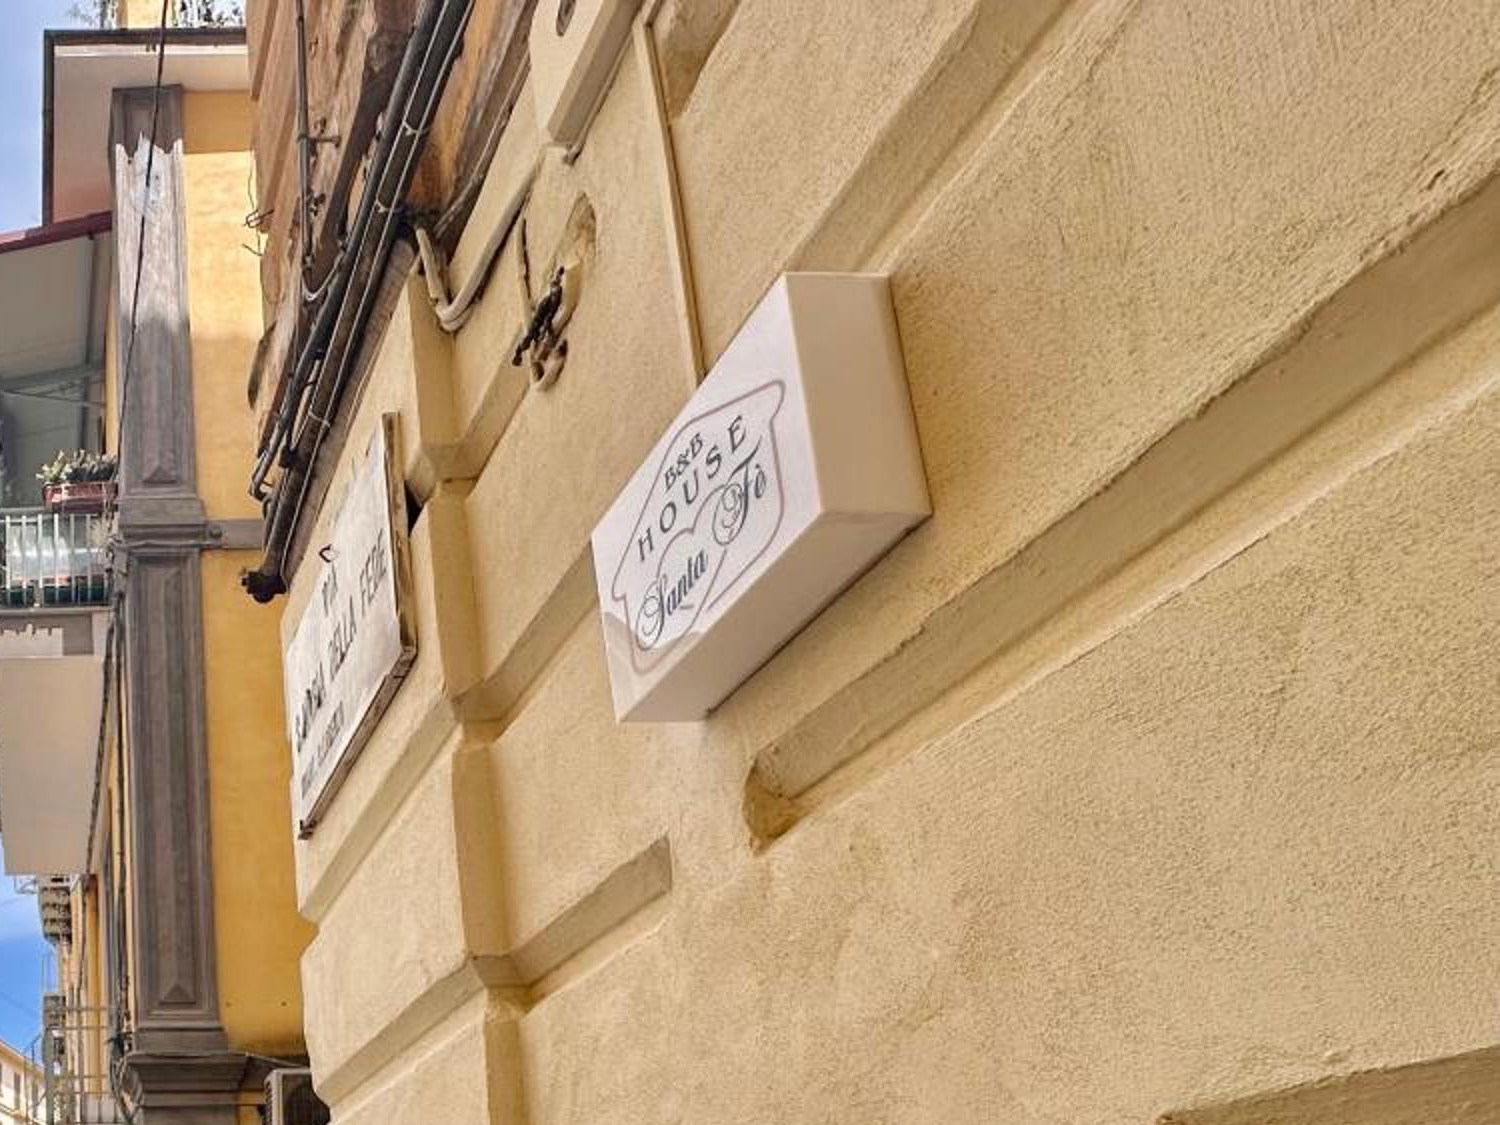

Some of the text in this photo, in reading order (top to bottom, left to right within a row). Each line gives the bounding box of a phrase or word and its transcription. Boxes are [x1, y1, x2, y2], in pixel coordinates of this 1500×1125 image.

[636, 415, 747, 563] HOUSE
[663, 432, 704, 493] B&B
[328, 595, 357, 682] DELLA
[359, 528, 387, 618] FEDE
[635, 549, 708, 651] Santa
